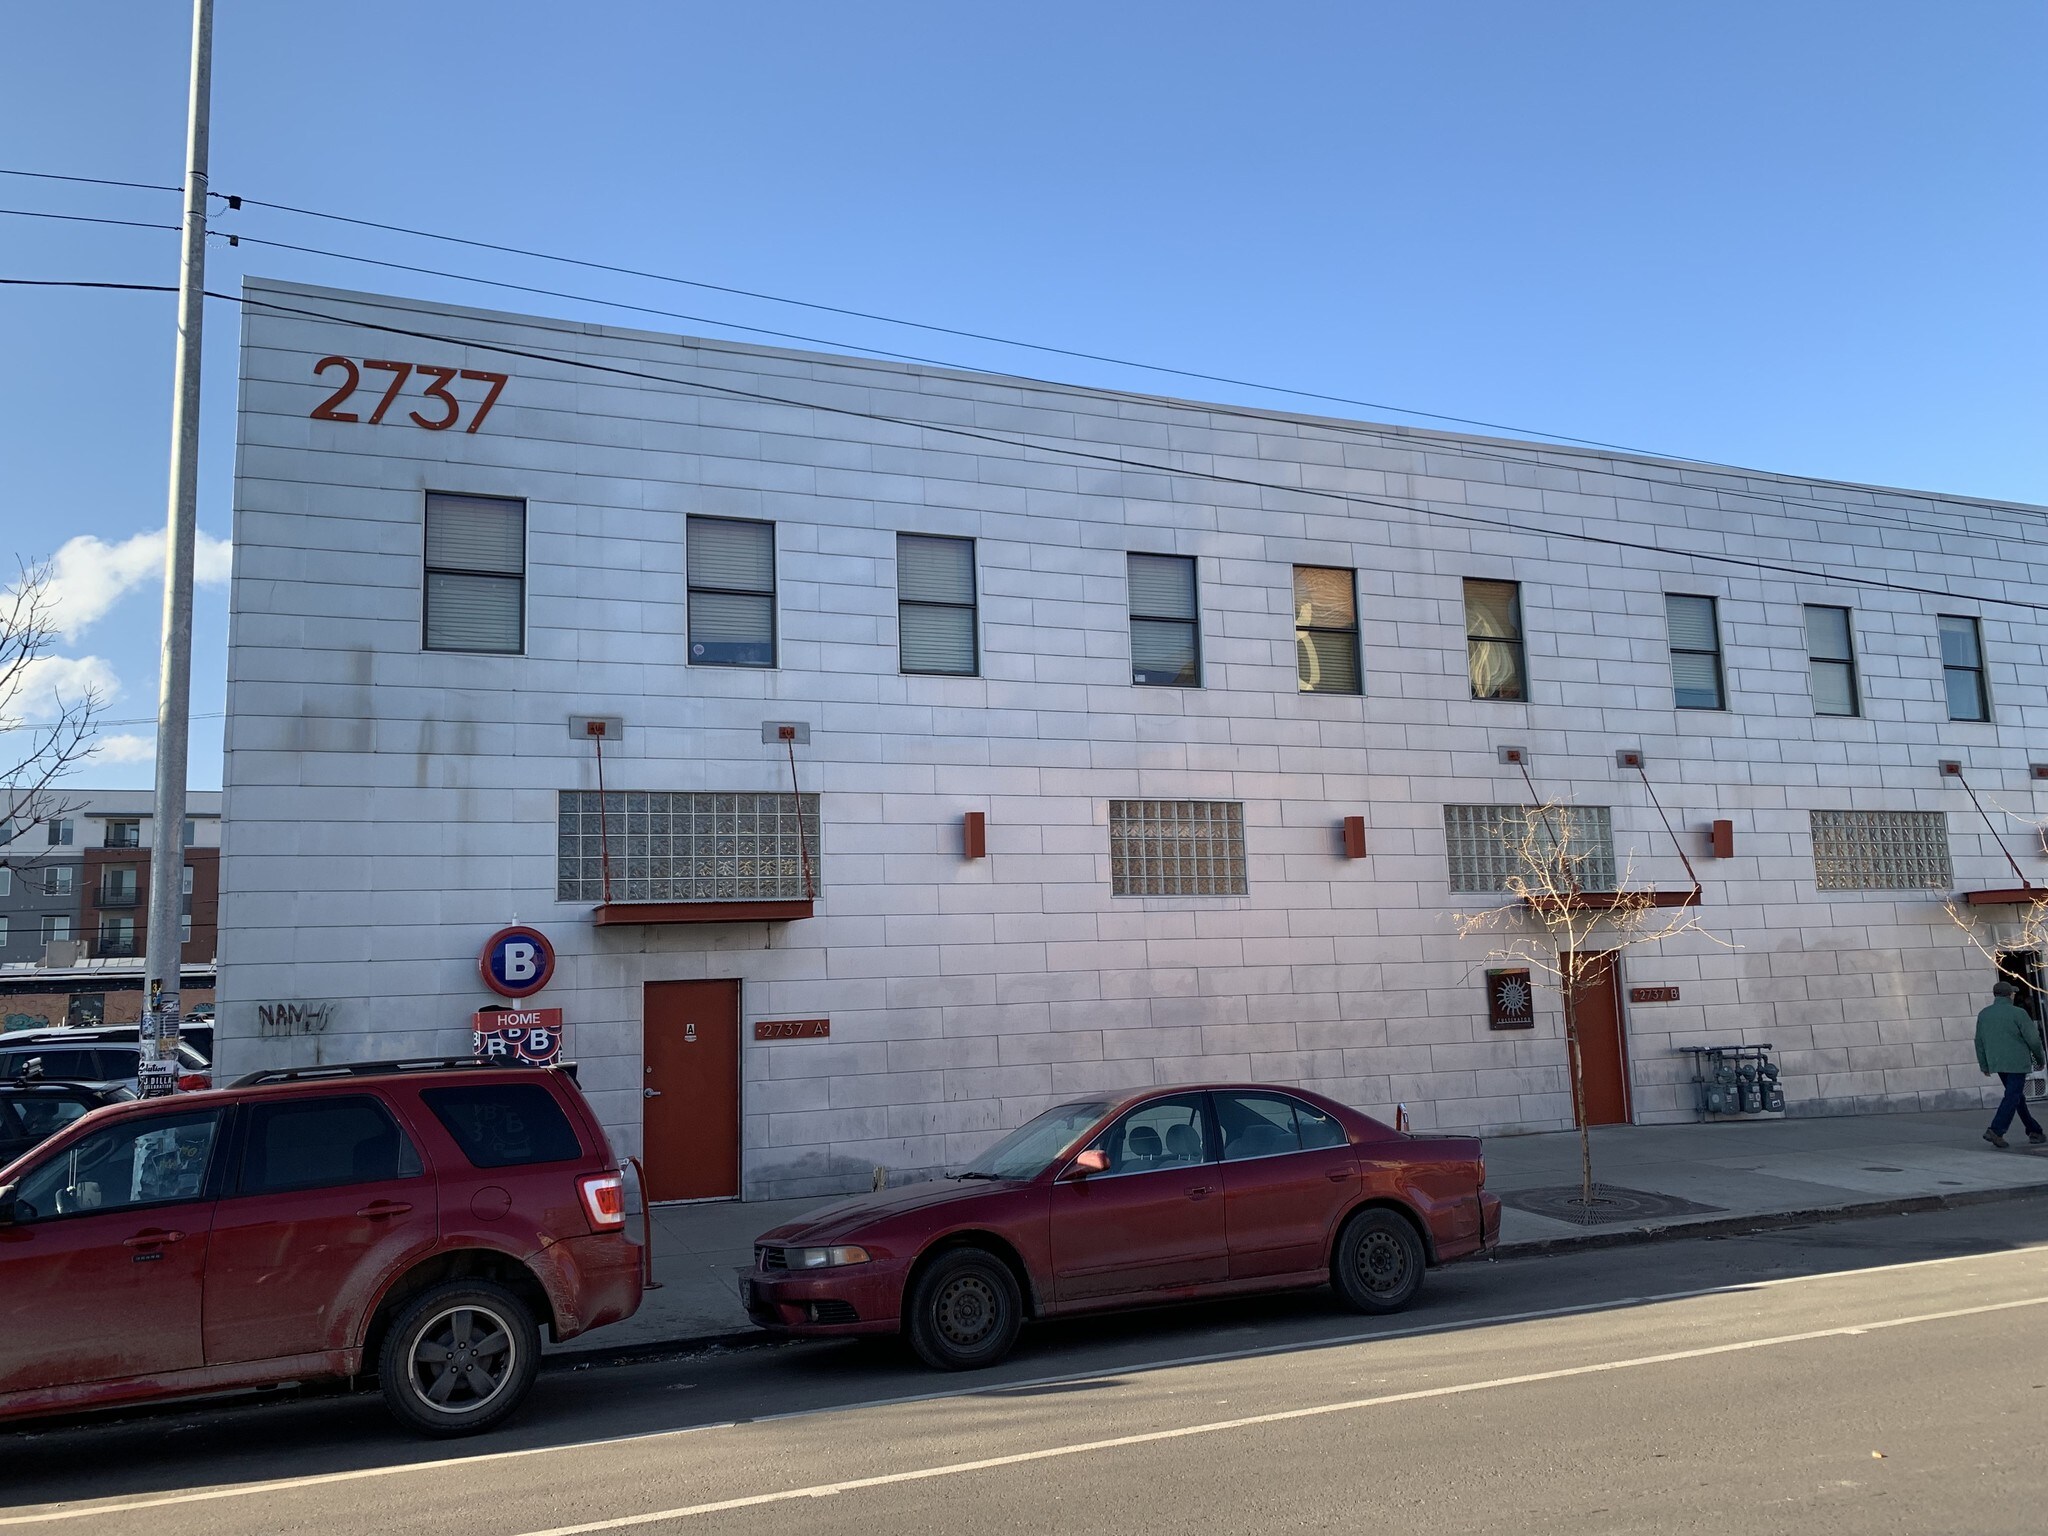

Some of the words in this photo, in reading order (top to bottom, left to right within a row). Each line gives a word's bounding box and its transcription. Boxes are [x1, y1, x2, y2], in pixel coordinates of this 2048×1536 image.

[310, 355, 509, 434] 2737
[505, 942, 536, 980] B
[1639, 989, 1665, 1000] 2737
[1671, 988, 1678, 999] B
[497, 1012, 541, 1026] HOME
[687, 1024, 694, 1034] A
[763, 1023, 804, 1037] 2737
[814, 1022, 824, 1035] A
[531, 1029, 549, 1050] B
[151, 1077, 171, 1085] DILLA
